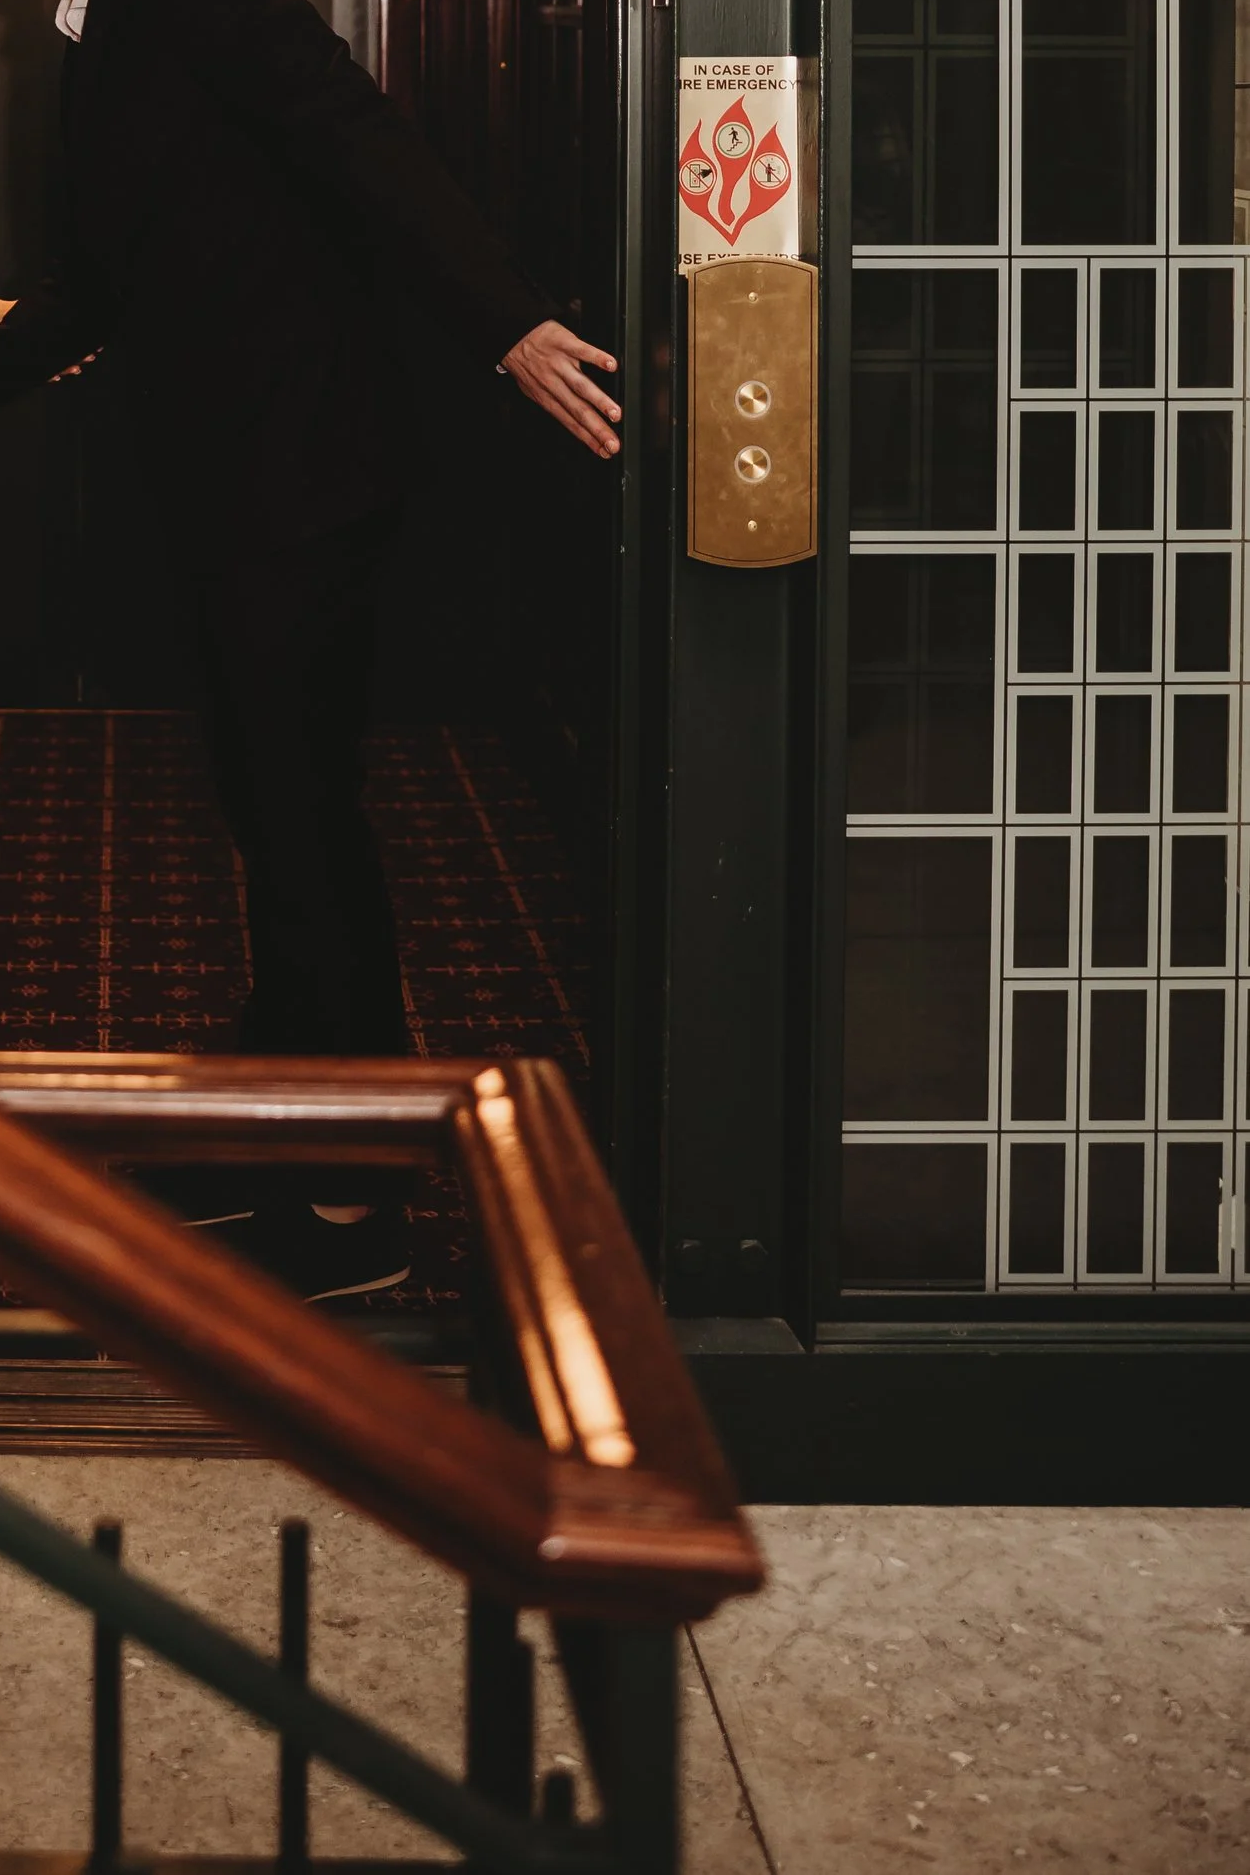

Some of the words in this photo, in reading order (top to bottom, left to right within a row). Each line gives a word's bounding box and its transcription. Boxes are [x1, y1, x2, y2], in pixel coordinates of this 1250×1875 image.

[694, 65, 707, 75] IN
[712, 65, 751, 75] CASE
[755, 65, 775, 75] OF
[679, 79, 702, 90] IRE
[706, 79, 799, 90] EMERGENCY
